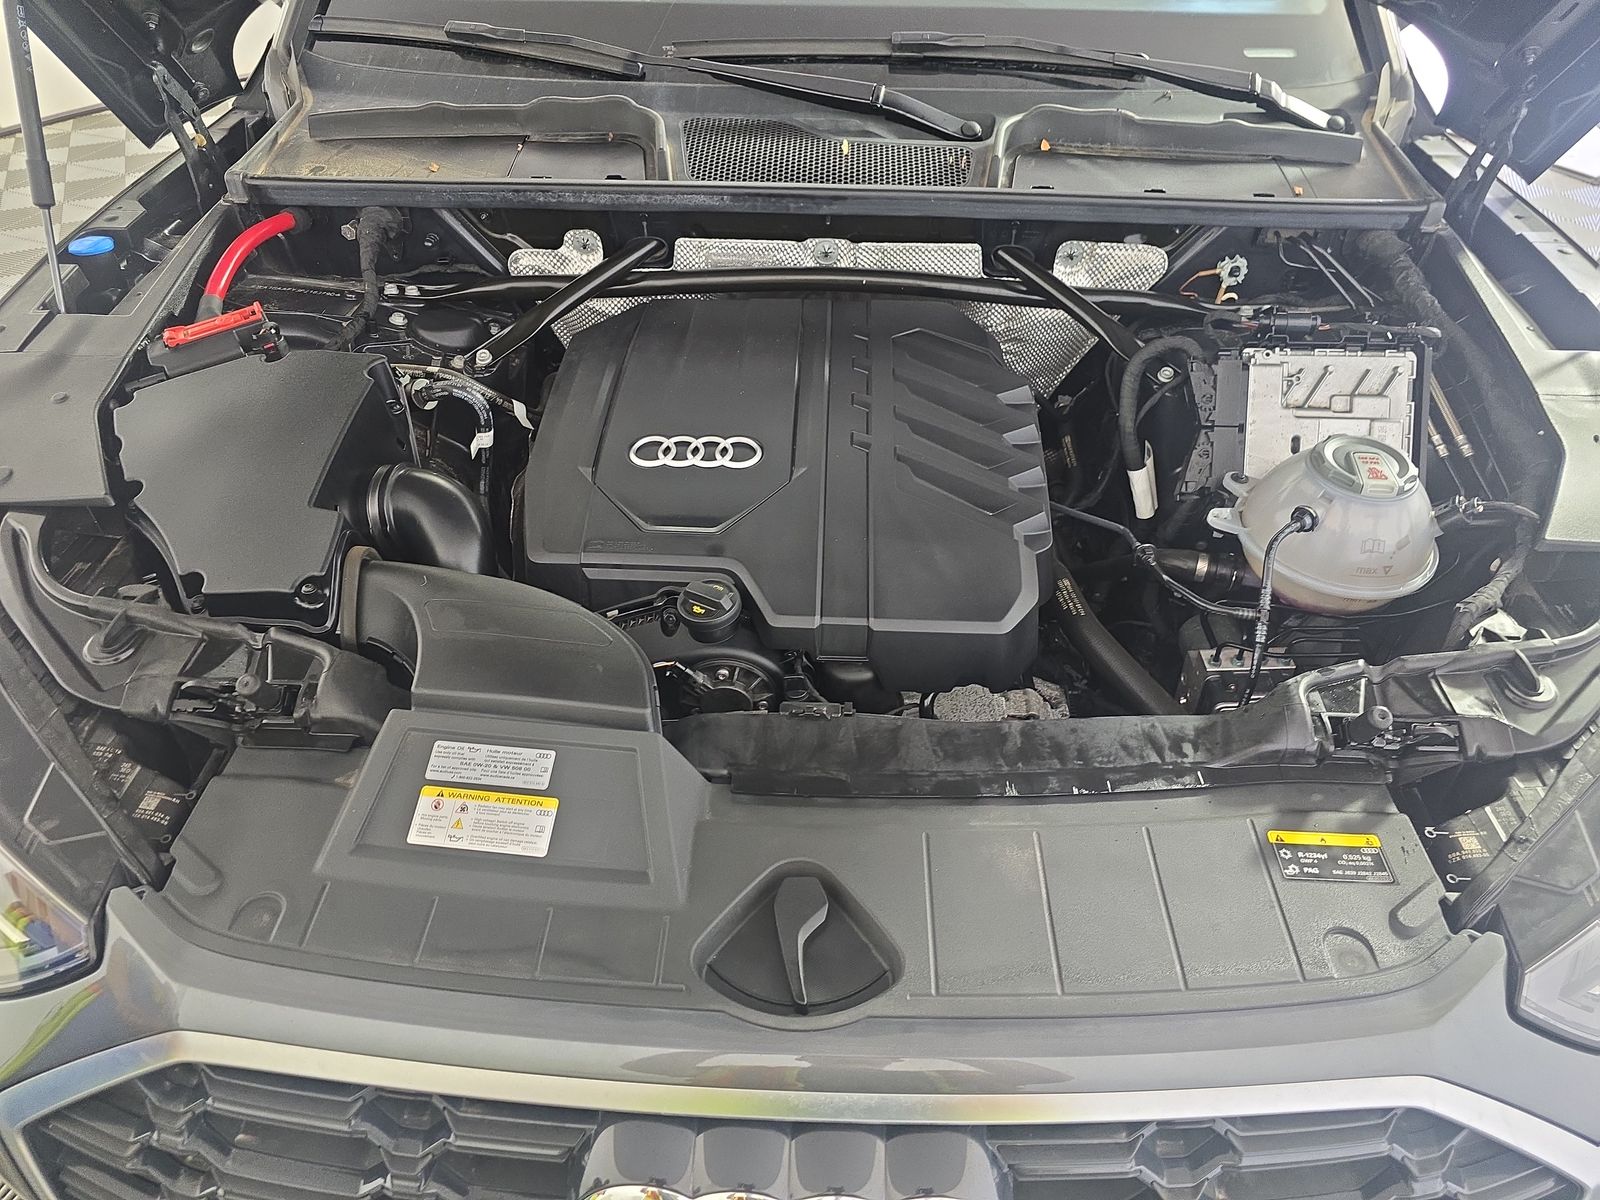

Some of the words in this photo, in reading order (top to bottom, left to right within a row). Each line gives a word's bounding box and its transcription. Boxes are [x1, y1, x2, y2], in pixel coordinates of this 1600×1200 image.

[448, 792, 490, 802] WARNING
[494, 796, 544, 807] ATTENTION
[1297, 851, 1328, 860] R-1234yf
